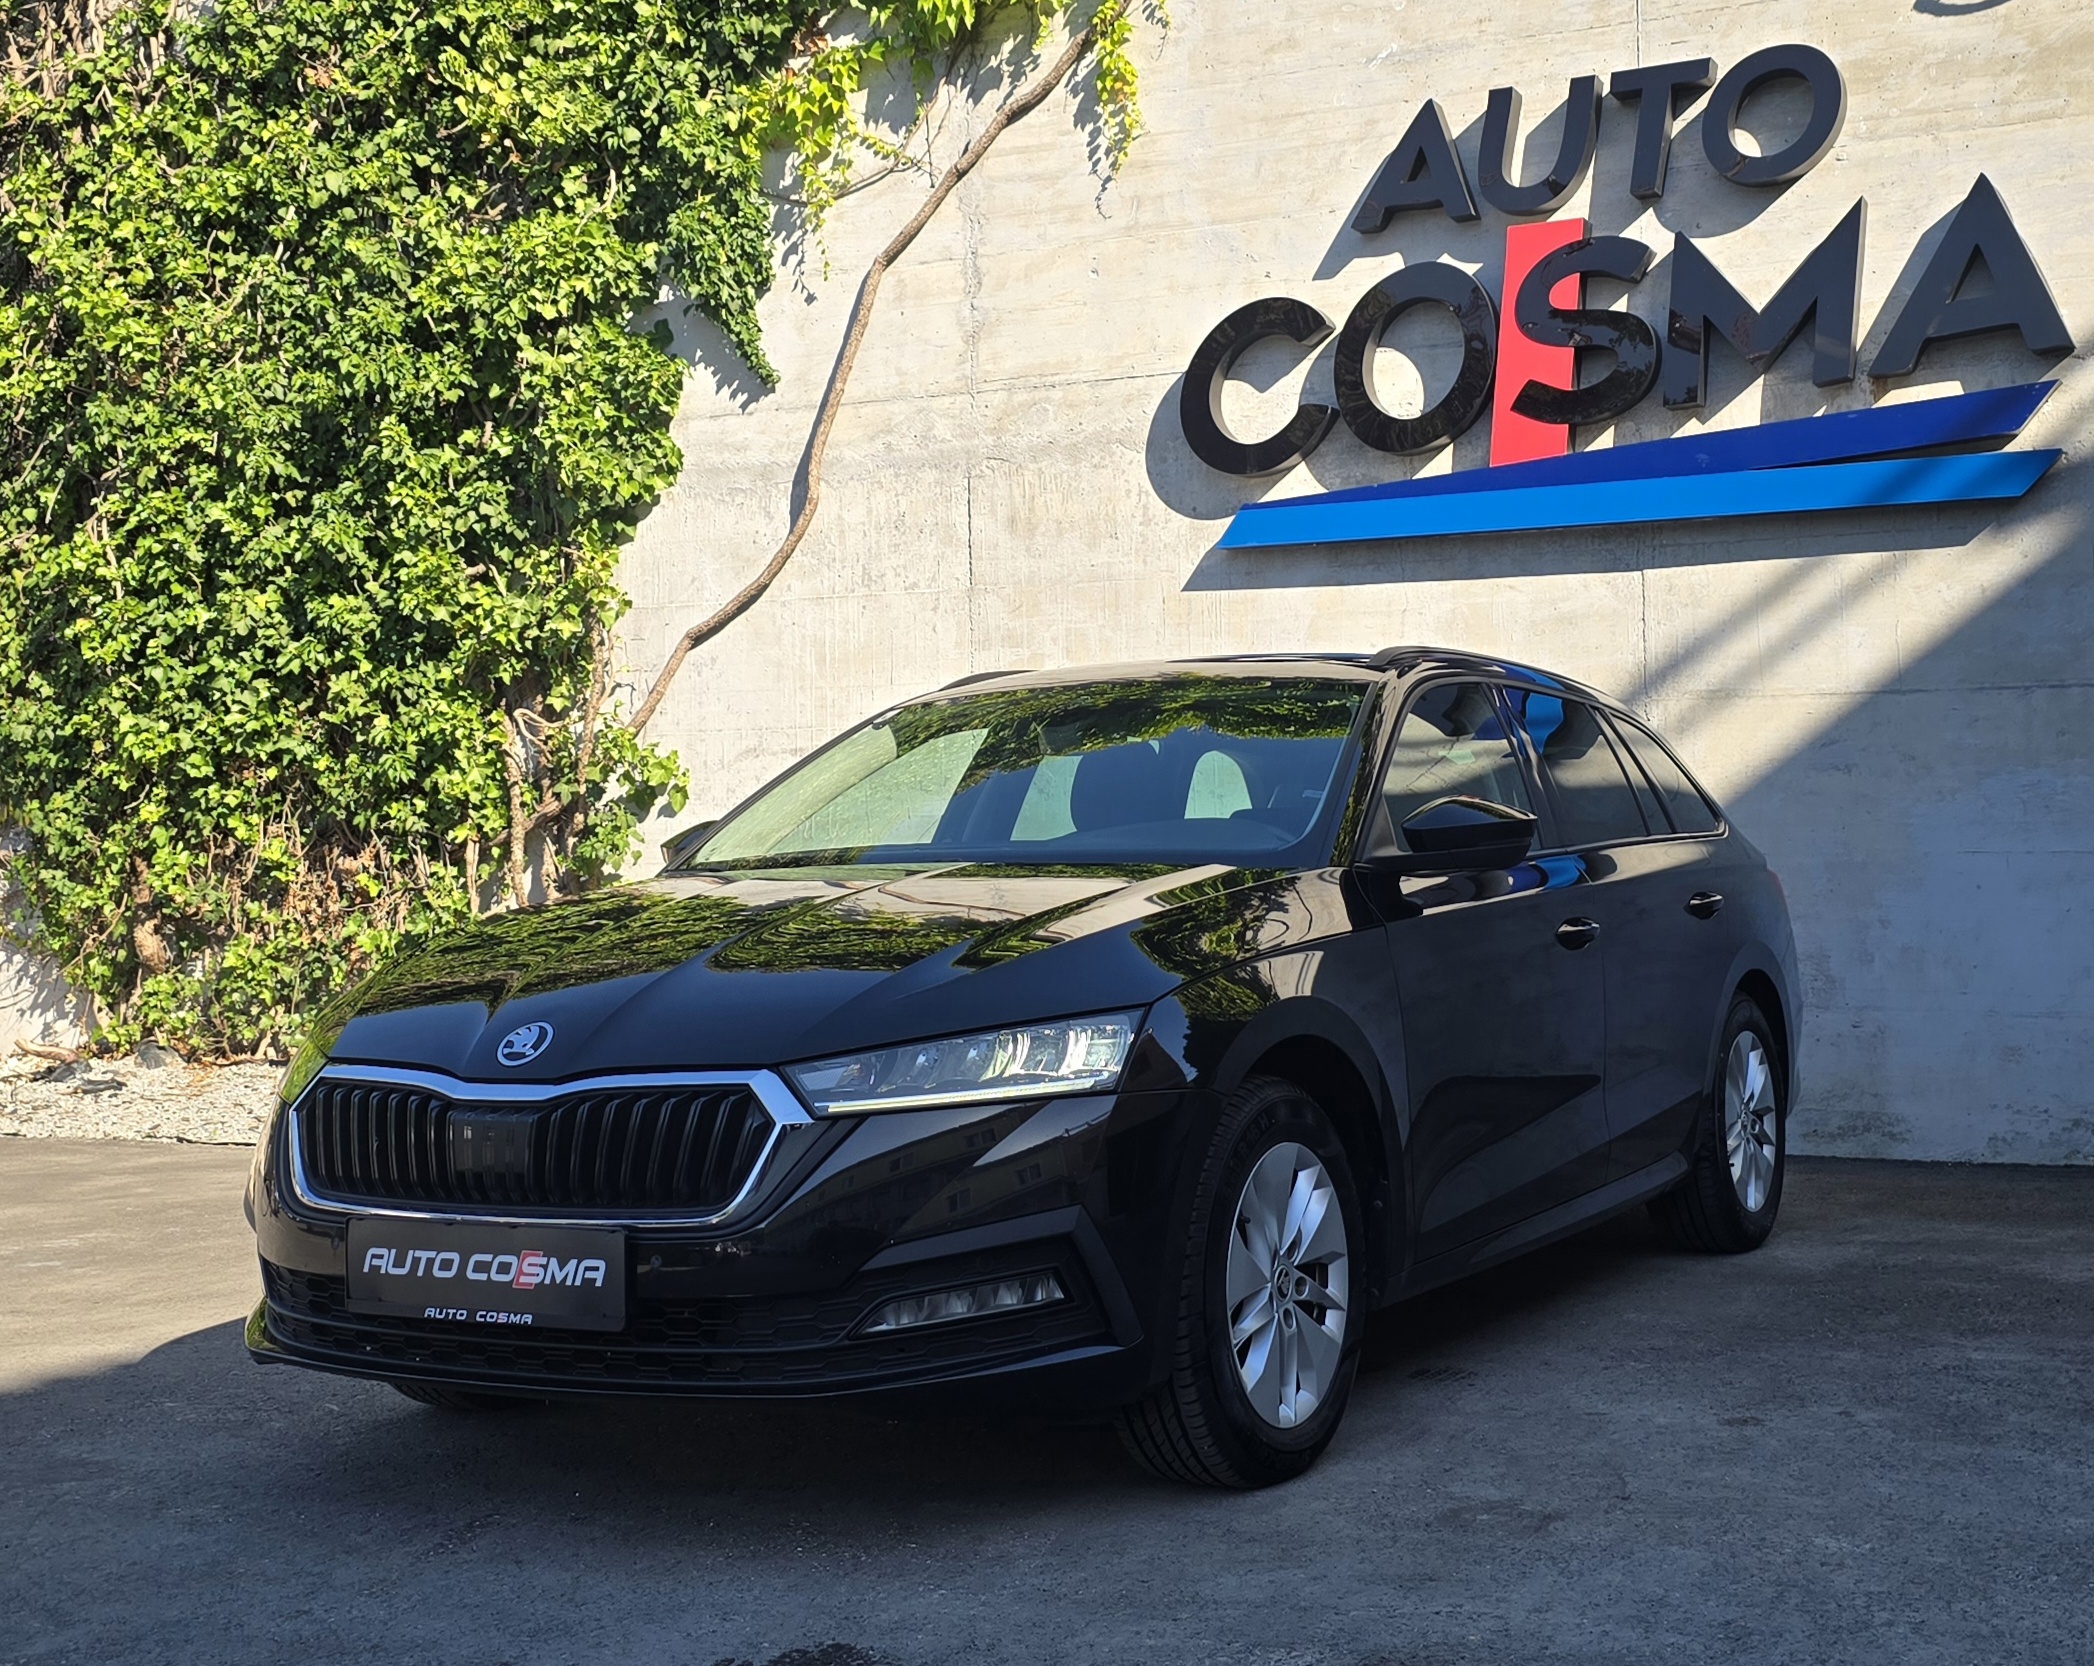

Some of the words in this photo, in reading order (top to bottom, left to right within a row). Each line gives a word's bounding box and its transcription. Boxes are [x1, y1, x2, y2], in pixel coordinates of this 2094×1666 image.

[1350, 43, 1848, 235] AUTO
[1179, 172, 2076, 478] COSMA
[363, 1247, 460, 1278] AUTO
[466, 1252, 607, 1287] COSMA
[424, 1307, 468, 1320] AUTO
[476, 1311, 533, 1325] COSMA
